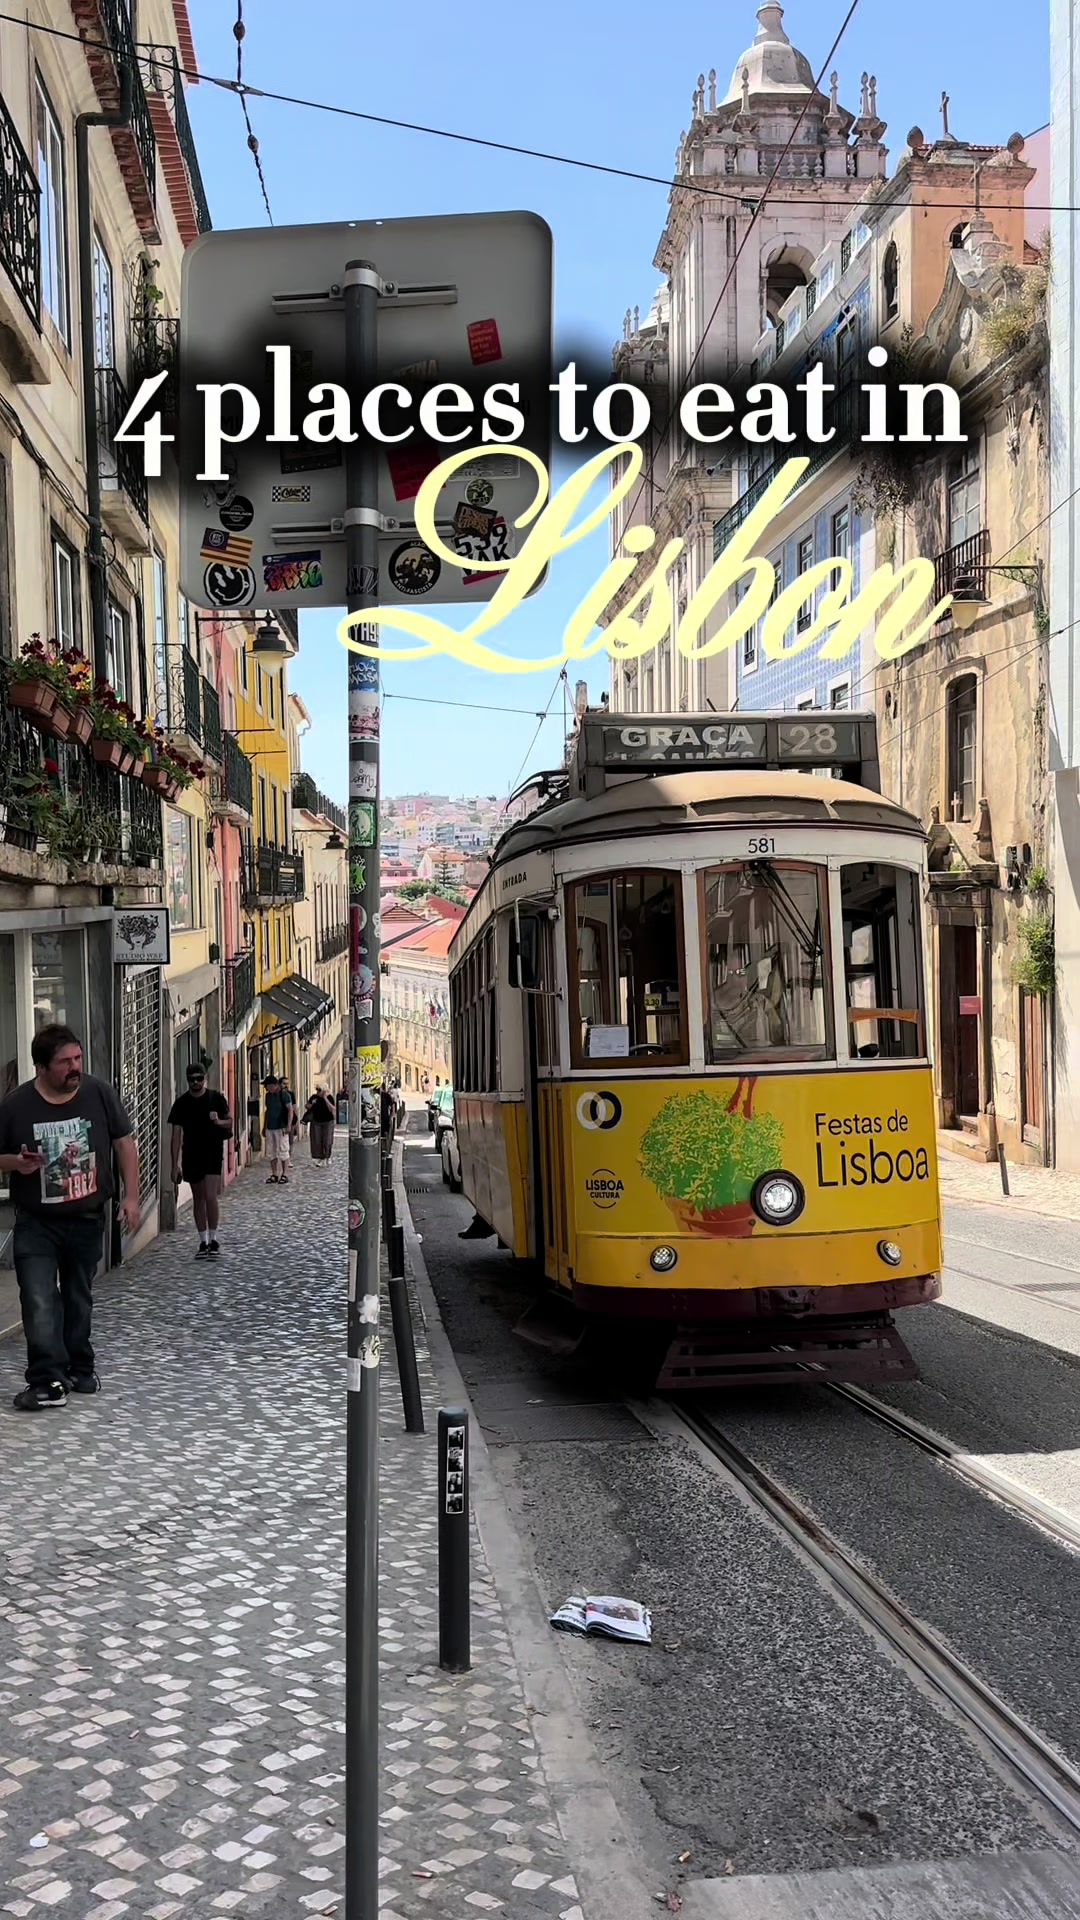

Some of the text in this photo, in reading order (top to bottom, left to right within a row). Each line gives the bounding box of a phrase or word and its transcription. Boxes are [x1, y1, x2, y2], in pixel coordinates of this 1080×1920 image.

[620, 724, 838, 754] GRAÇA 28
[747, 838, 776, 854] 581
[502, 871, 528, 891] ENTRADA
[815, 1109, 909, 1137] Festas de
[815, 1138, 930, 1188] Lisboa
[67, 1171, 95, 1200] 1962
[585, 1179, 625, 1191] LISBOA
[590, 1191, 621, 1199] CULTURA
